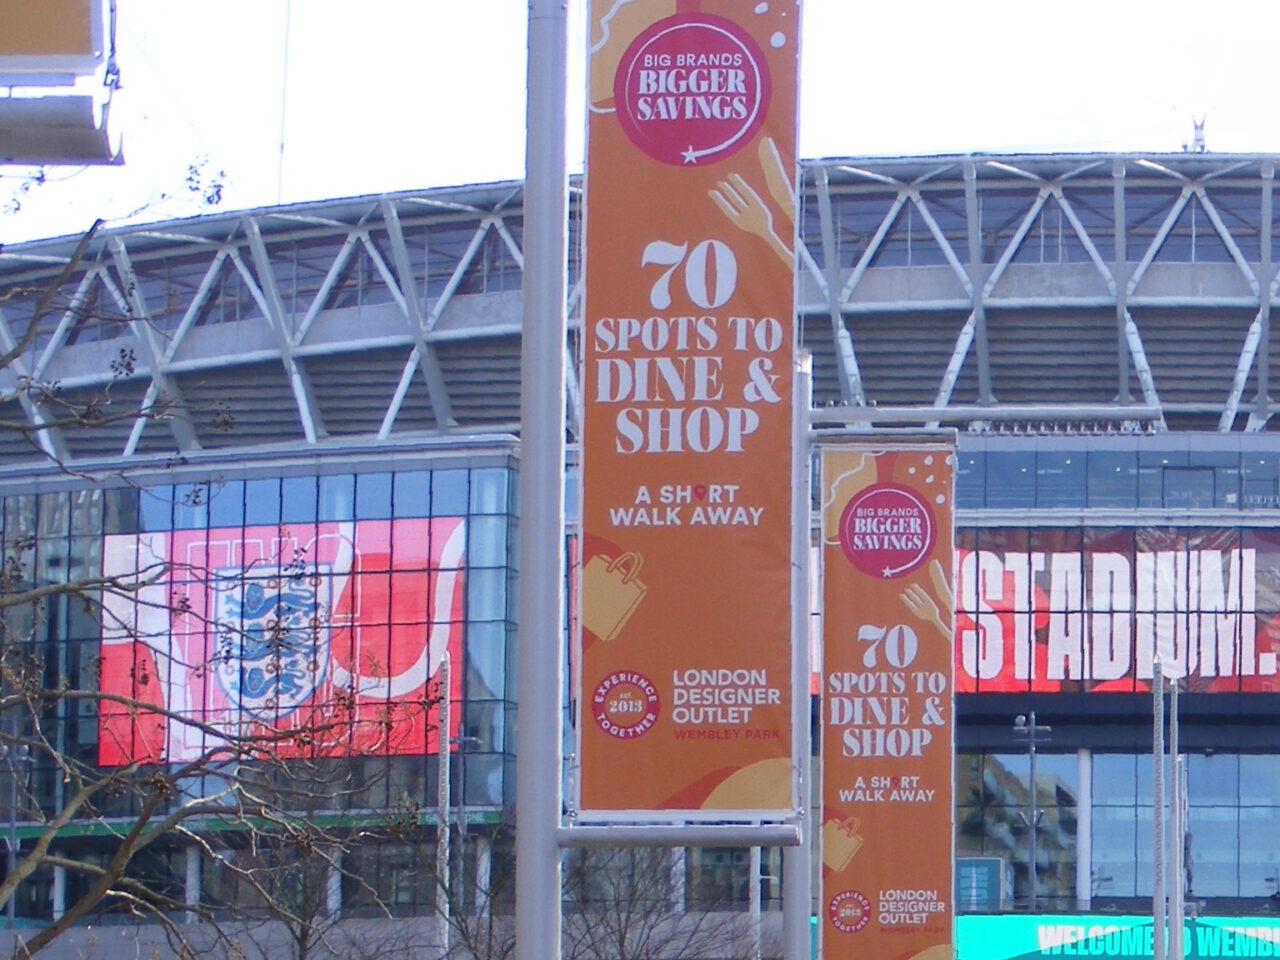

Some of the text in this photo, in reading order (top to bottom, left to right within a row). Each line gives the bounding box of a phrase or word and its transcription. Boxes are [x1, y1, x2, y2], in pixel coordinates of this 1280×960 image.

[644, 53, 743, 67] BIG BRANDS
[638, 69, 747, 95] BIGGER
[637, 96, 748, 121] SAVINGS
[642, 239, 738, 310] 70
[595, 316, 783, 352] SPOTS TO
[595, 356, 782, 403] DINE &
[615, 407, 760, 454] SHOP
[635, 486, 651, 504] A
[610, 507, 764, 526] WALK AWAY
[856, 507, 919, 517] BIG BRANDS
[854, 518, 922, 534] BIGGER
[853, 534, 923, 551] SAVINGS
[857, 624, 918, 669] 70
[673, 669, 767, 686] LONDON
[829, 672, 946, 694] SPOTS TO
[594, 673, 657, 703] EXPERIENCE
[673, 688, 781, 705] DESIGNER
[609, 700, 643, 713] 2013
[672, 707, 752, 724] OUTLET
[830, 696, 946, 726] DINE &
[597, 712, 656, 738] TOGETHER
[674, 729, 780, 740] WEMBLEY PARK
[842, 728, 932, 757] SHOP
[854, 776, 866, 788] A
[839, 789, 935, 801] WALK AWAY
[879, 890, 937, 900] LONDON
[879, 902, 945, 912] DESIGNER
[878, 913, 928, 924] OUTLET
[1038, 925, 1154, 956] WELCOME
